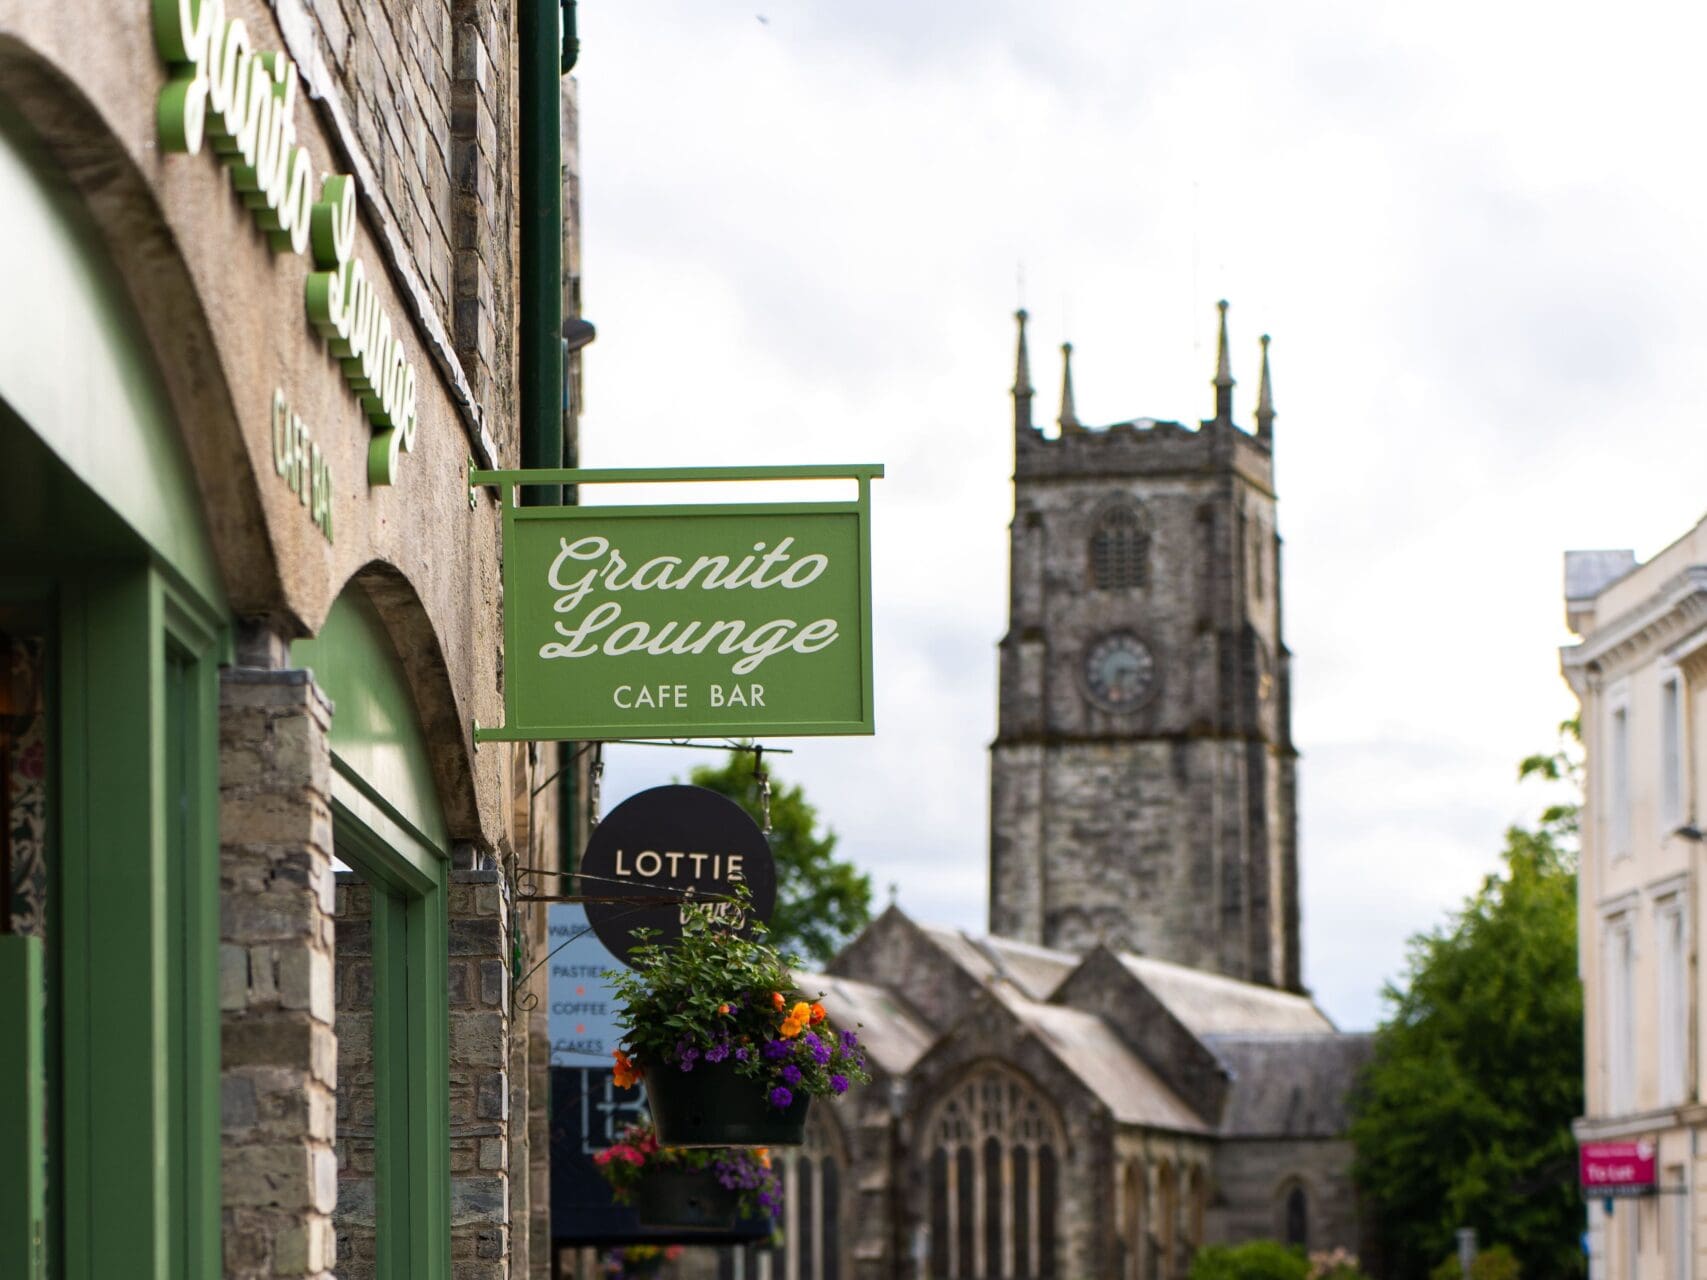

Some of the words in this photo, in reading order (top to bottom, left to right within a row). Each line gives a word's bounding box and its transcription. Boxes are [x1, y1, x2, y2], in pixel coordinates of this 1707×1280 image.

[327, 173, 416, 486] Lounge
[548, 536, 829, 613] Granito
[539, 601, 840, 675] Lounge
[613, 685, 688, 709] CAFE
[710, 684, 766, 708] BAR
[615, 850, 744, 881] LOTTIE
[552, 1003, 607, 1016] COFFEE
[556, 1039, 604, 1051] CAKES
